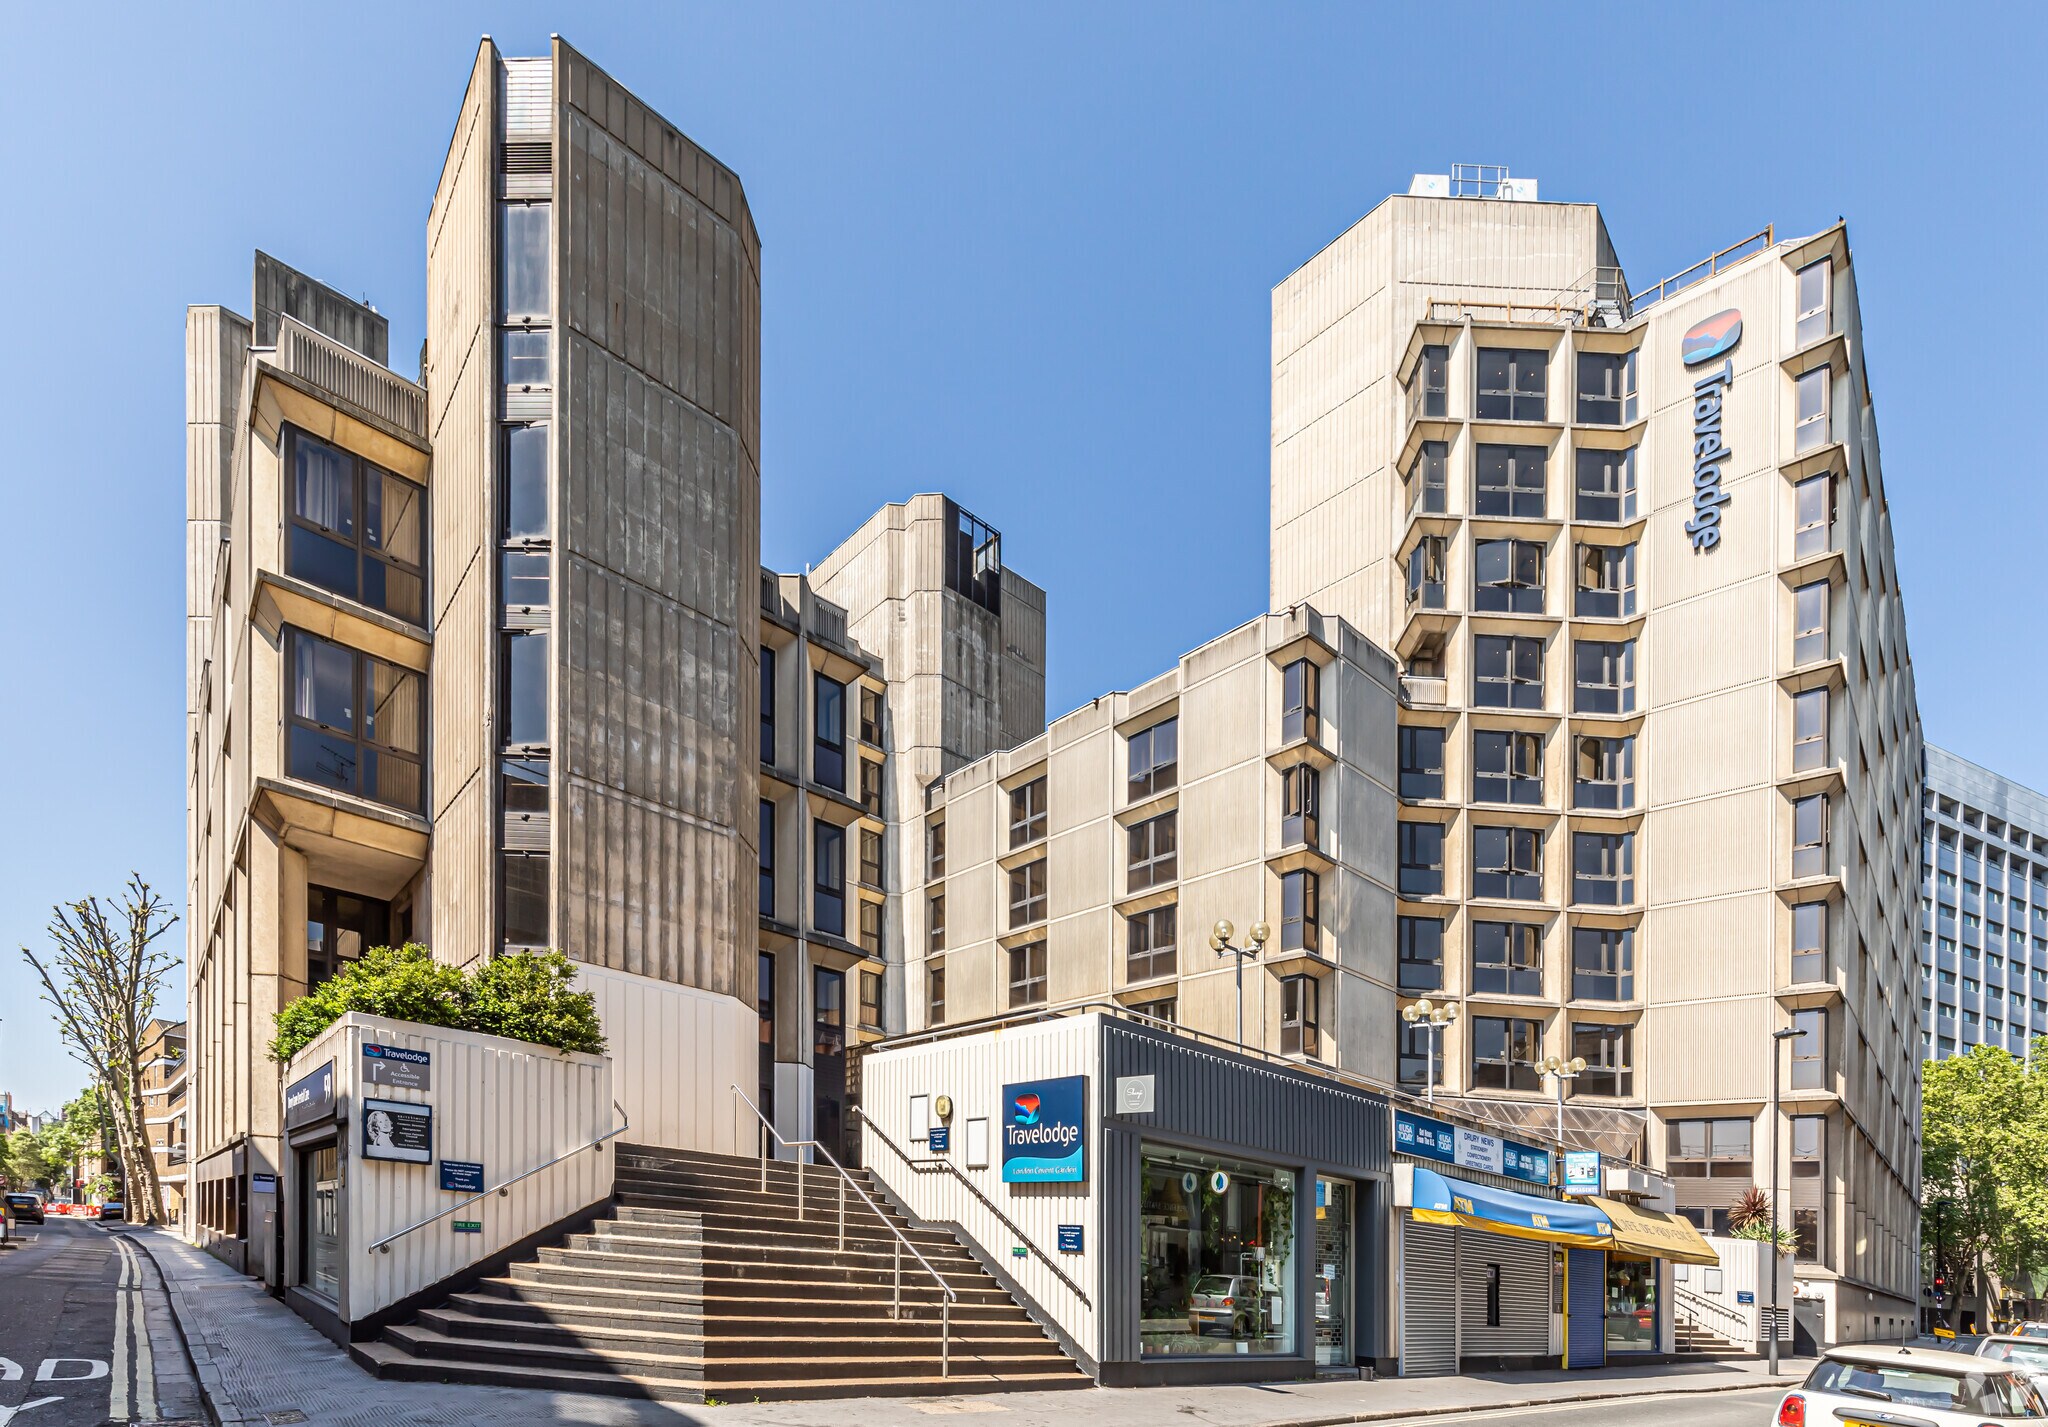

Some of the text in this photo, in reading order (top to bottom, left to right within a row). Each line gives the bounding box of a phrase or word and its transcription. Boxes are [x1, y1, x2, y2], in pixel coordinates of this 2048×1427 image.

[1685, 358, 1733, 548] Travelodge
[384, 1048, 428, 1063] Travelodge
[391, 1071, 420, 1080] Accessible
[393, 1079, 418, 1087] Entrance
[1404, 1124, 1412, 1133] USA
[1006, 1121, 1079, 1147] Travelodge
[1398, 1131, 1413, 1142] TODAY
[1464, 1132, 1494, 1147] DRURY NEWS
[1438, 1141, 1452, 1151] TODAY
[1470, 1144, 1488, 1152] STATIONERY
[1467, 1152, 1491, 1161] CONFECTIONERY
[1465, 1160, 1493, 1171] GREETINGS CARDS
[1505, 1158, 1517, 1167] TODAY
[1012, 1167, 1034, 1175] London
[1055, 1165, 1077, 1174] Garden
[1434, 1202, 1448, 1210] ATM
[1453, 1196, 1475, 1215] ATM
[1531, 1213, 1550, 1229] ATM
[1596, 1222, 1612, 1235] ATM
